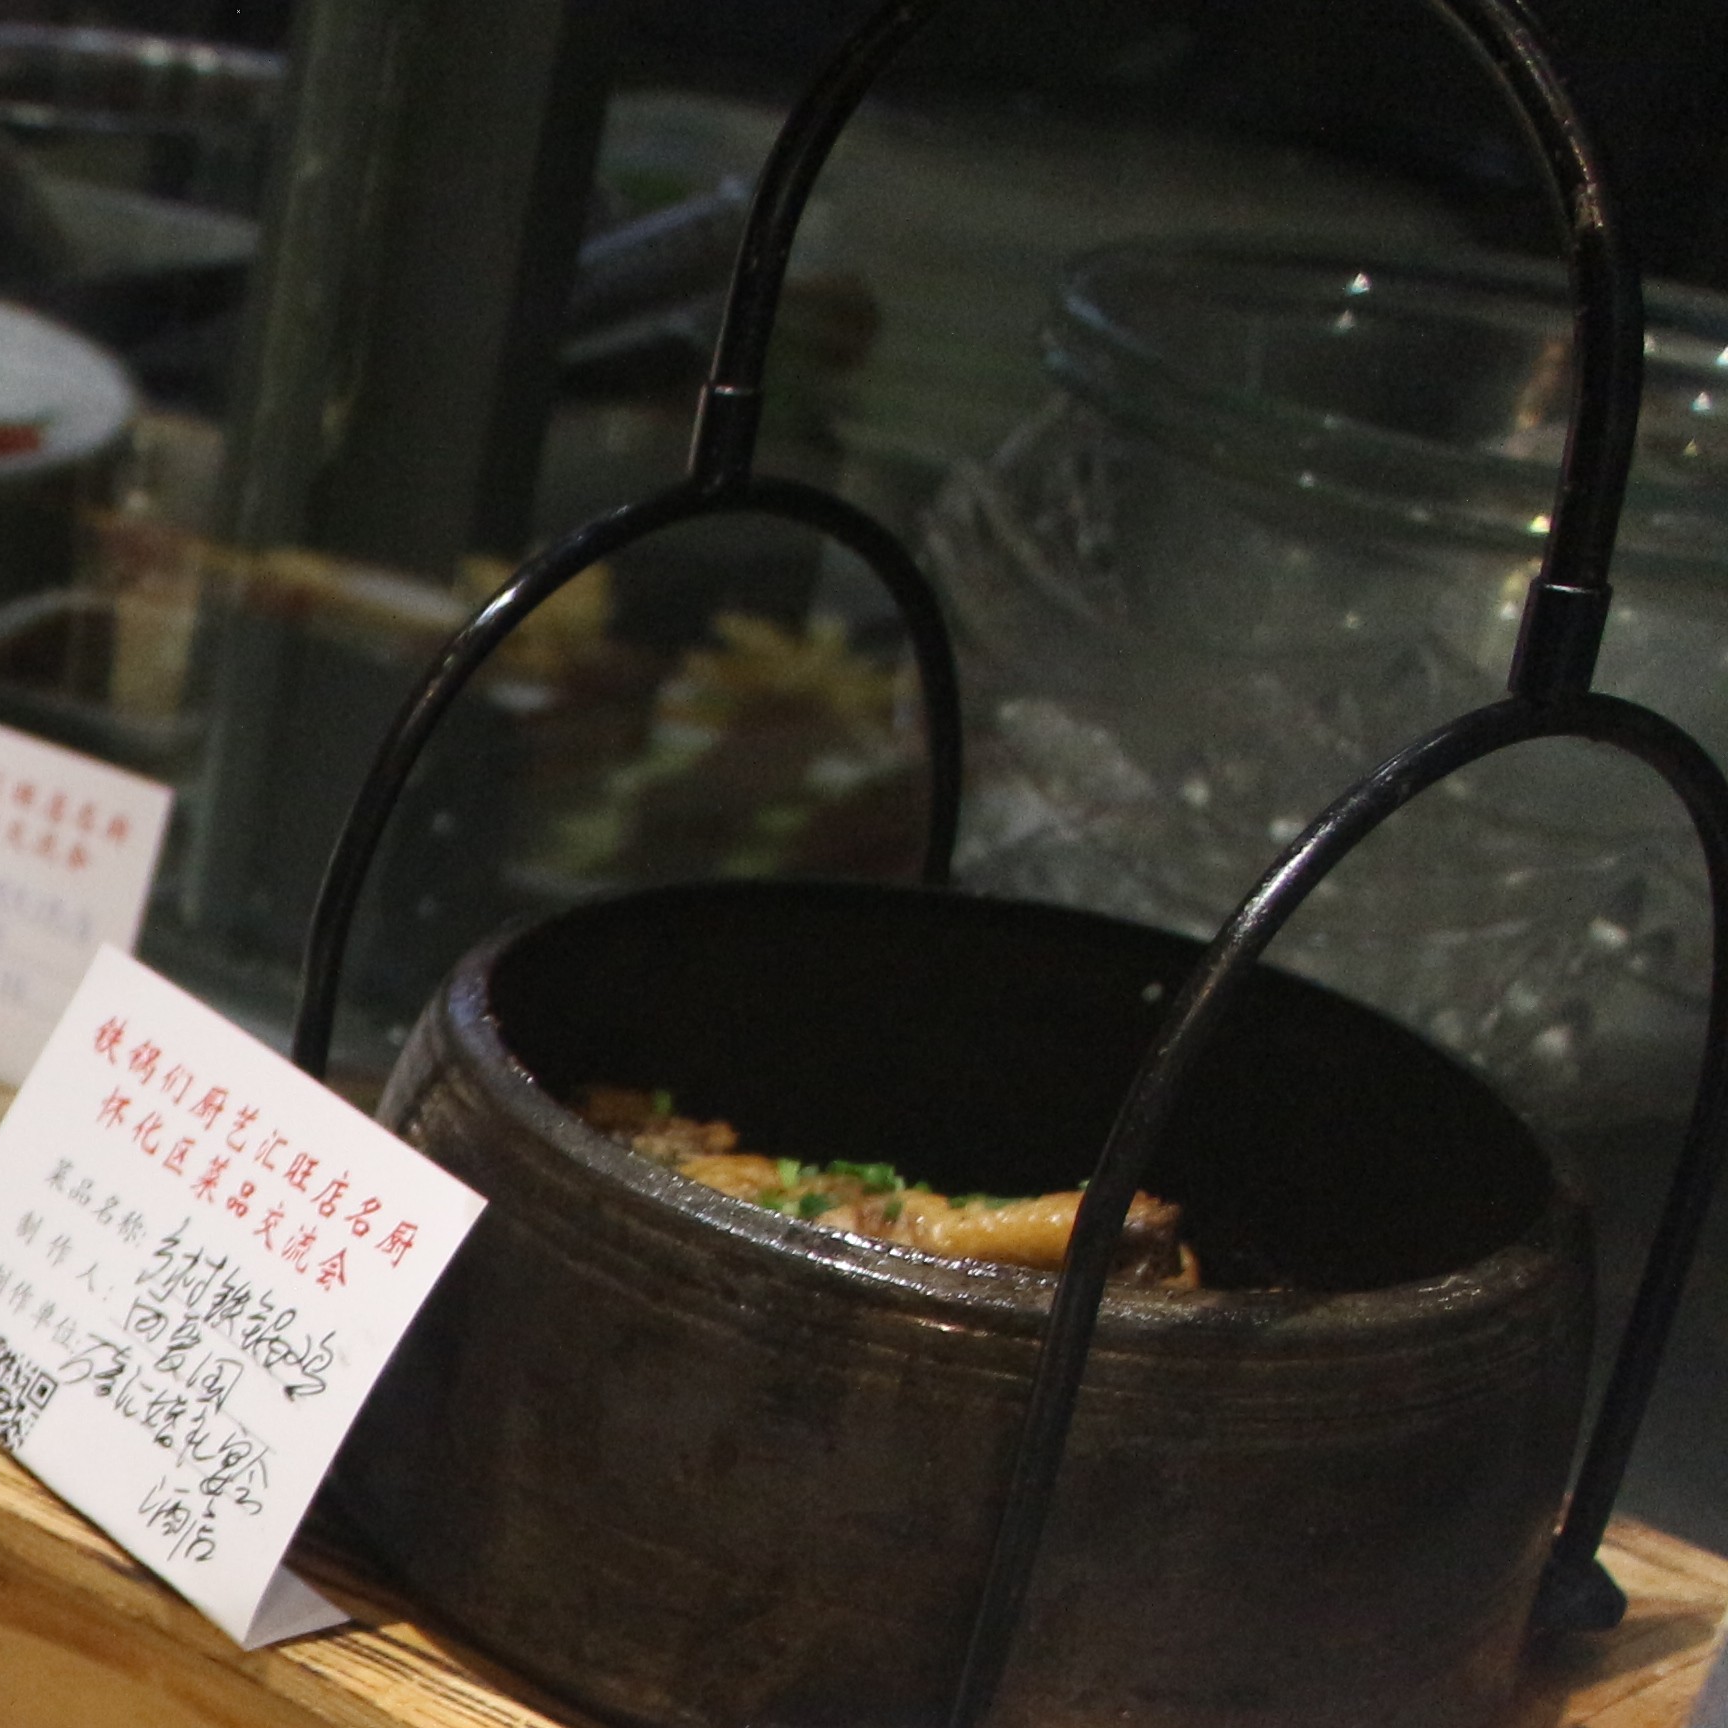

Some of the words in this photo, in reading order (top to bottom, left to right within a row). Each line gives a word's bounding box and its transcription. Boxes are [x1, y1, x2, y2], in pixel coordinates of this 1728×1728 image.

[94, 1017, 419, 1268] 铁锅们厨艺汇旺店名厨
[96, 1086, 349, 1293] 怀化区菜品交流会
